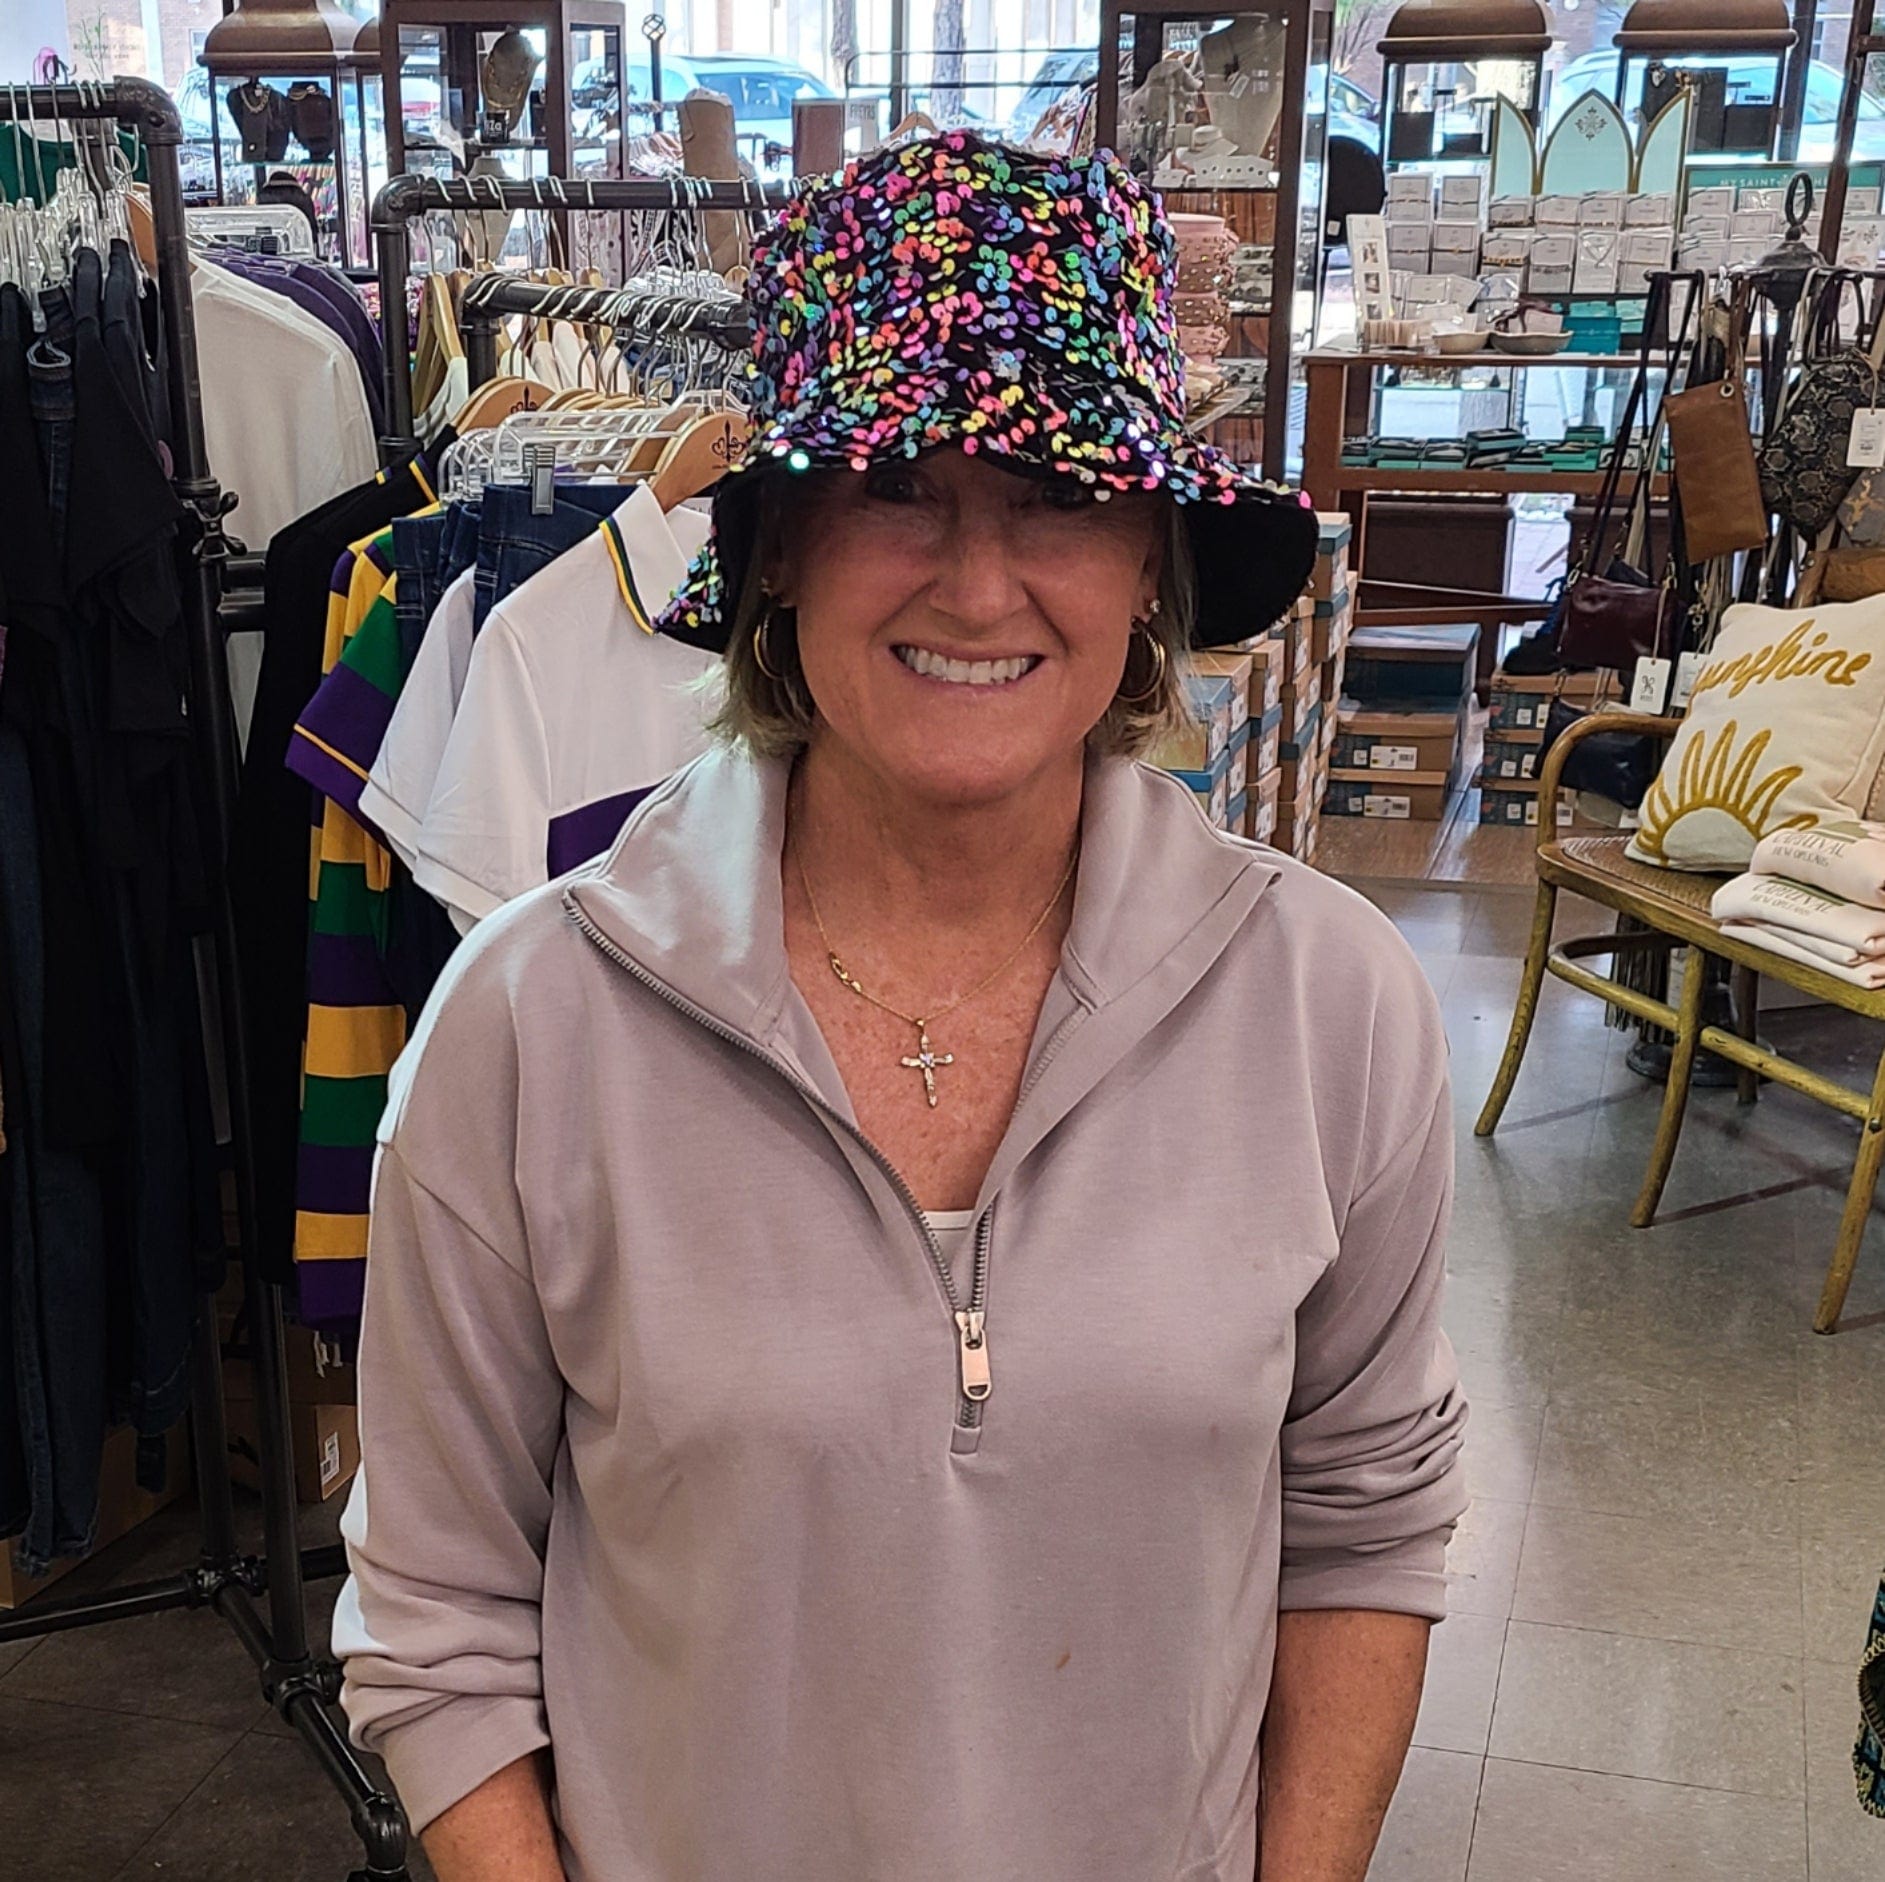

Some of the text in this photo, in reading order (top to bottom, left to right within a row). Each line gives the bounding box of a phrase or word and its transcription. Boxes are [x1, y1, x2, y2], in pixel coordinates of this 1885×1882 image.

[1720, 178, 1736, 187] MY
[1739, 177, 1776, 188] SAINT
[1691, 618, 1872, 699] unshine
[1772, 846, 1792, 857] NEW
